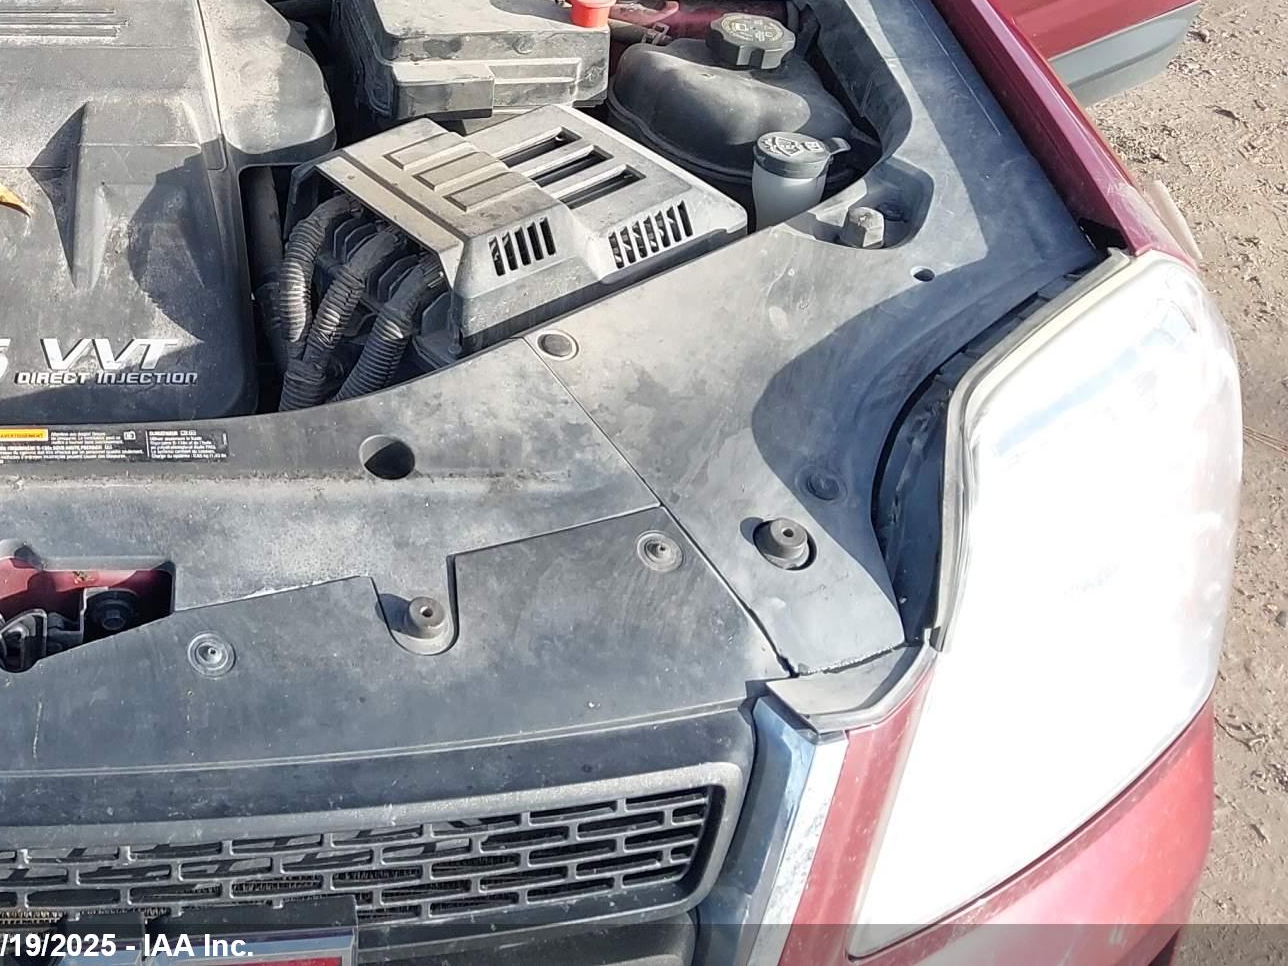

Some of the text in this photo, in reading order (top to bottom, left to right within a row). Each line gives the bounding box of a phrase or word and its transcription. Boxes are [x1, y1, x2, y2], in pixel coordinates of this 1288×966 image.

[39, 337, 179, 371] VVT
[16, 371, 198, 385] DIRECT INJECTION
